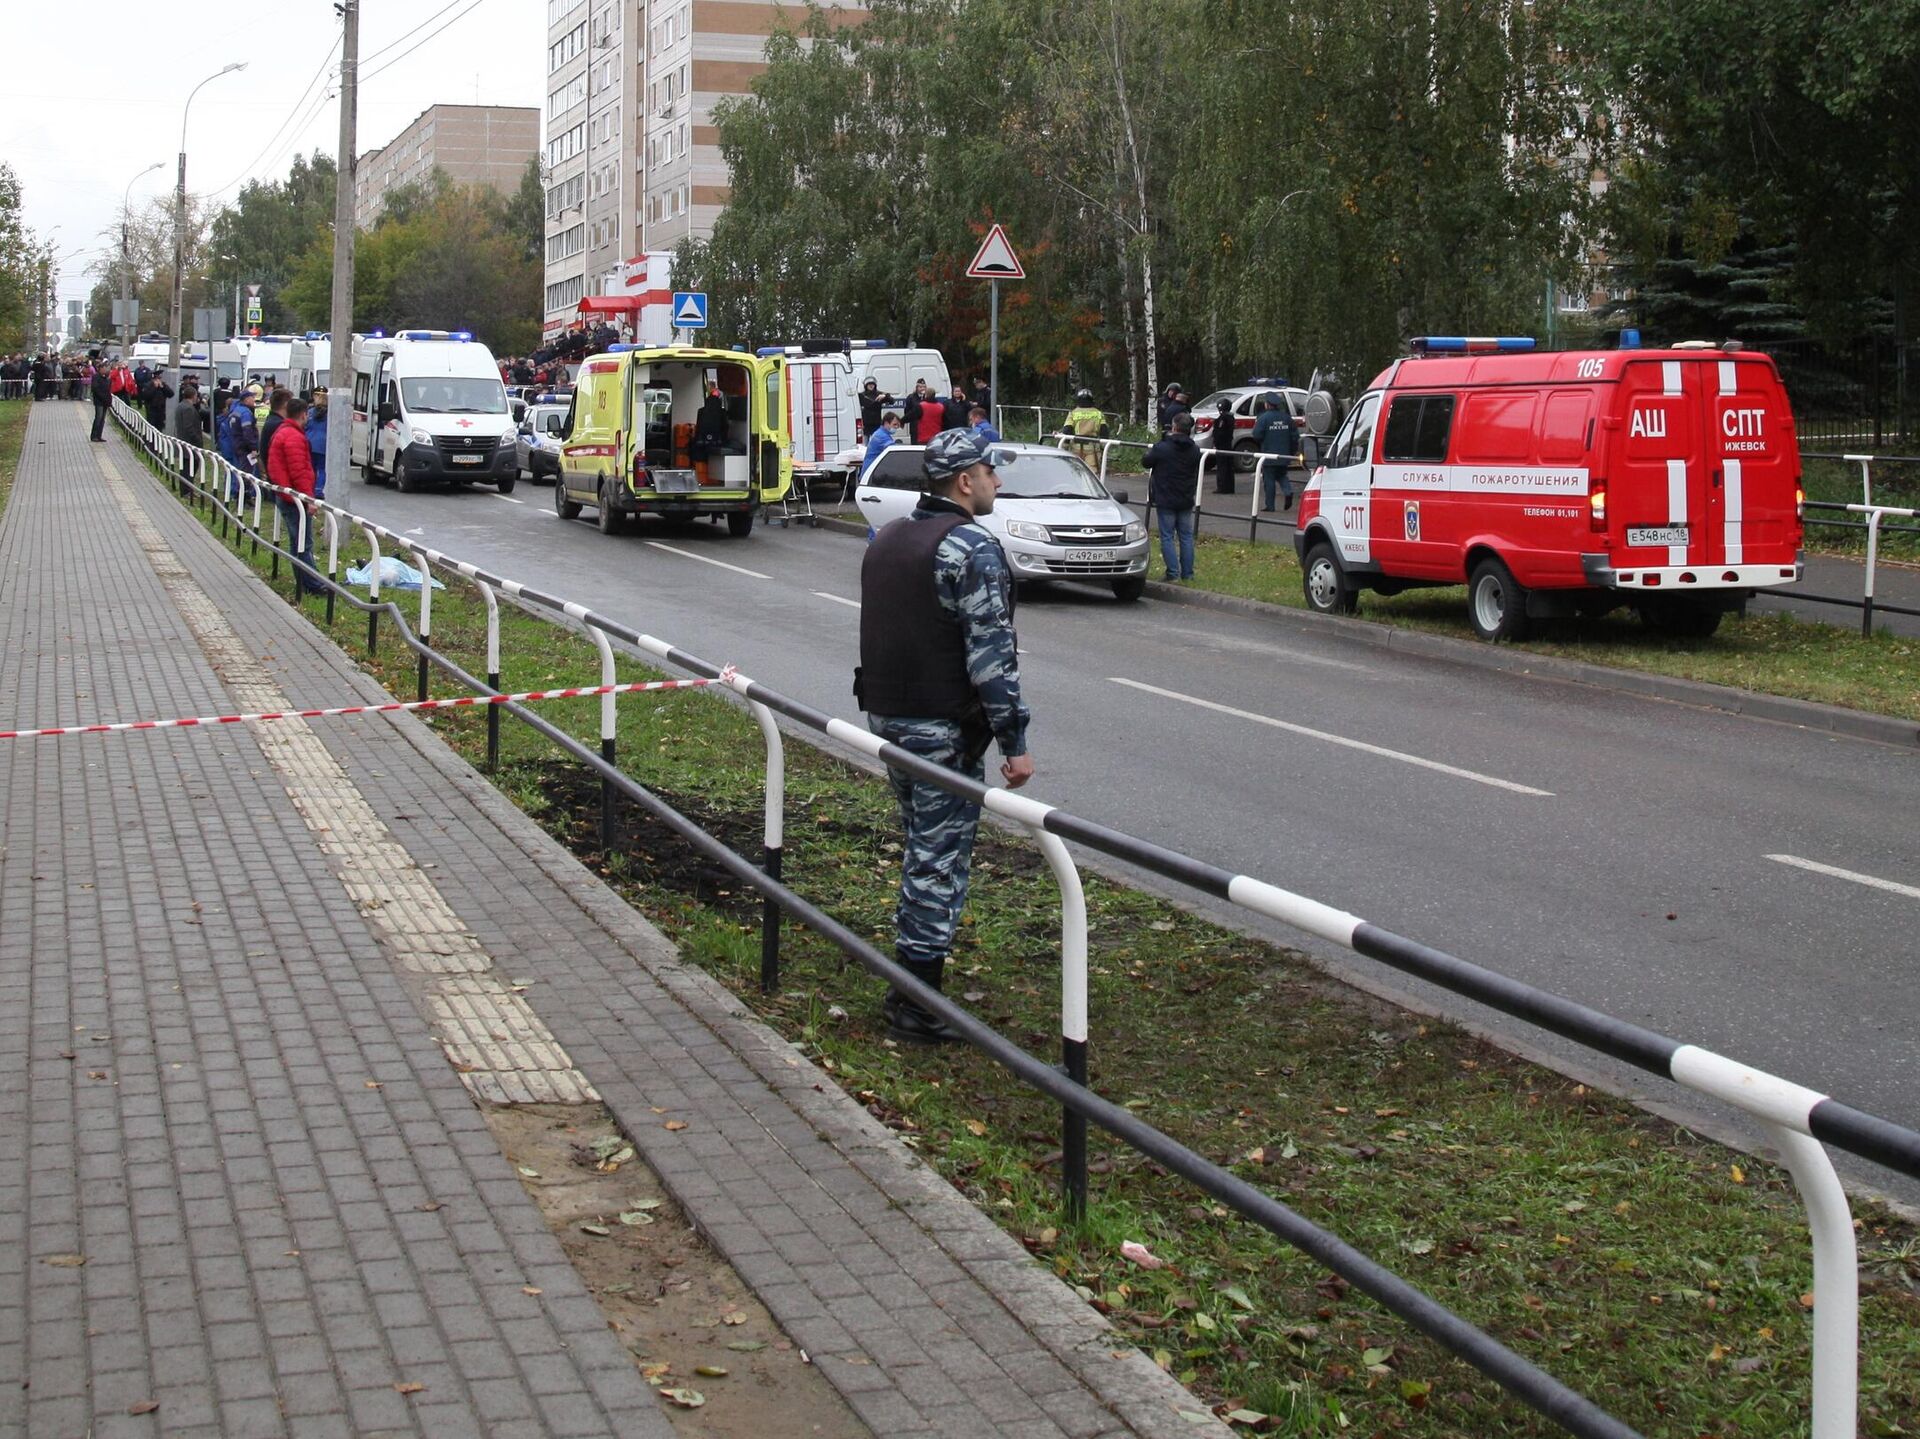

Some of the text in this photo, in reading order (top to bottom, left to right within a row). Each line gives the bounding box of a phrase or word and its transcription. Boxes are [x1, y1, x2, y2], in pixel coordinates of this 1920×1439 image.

[1577, 358, 1605, 378] 105
[1630, 409, 1666, 437] АШ
[1722, 409, 1765, 437] СПТ
[1725, 441, 1766, 451] ИЖЕВСК
[1402, 472, 1579, 486] СЛУЖБА ПОЖАРОТУШЕНИЯ
[1343, 506, 1364, 530] СПТ
[1523, 508, 1555, 517] ТЕЛЕФОН
